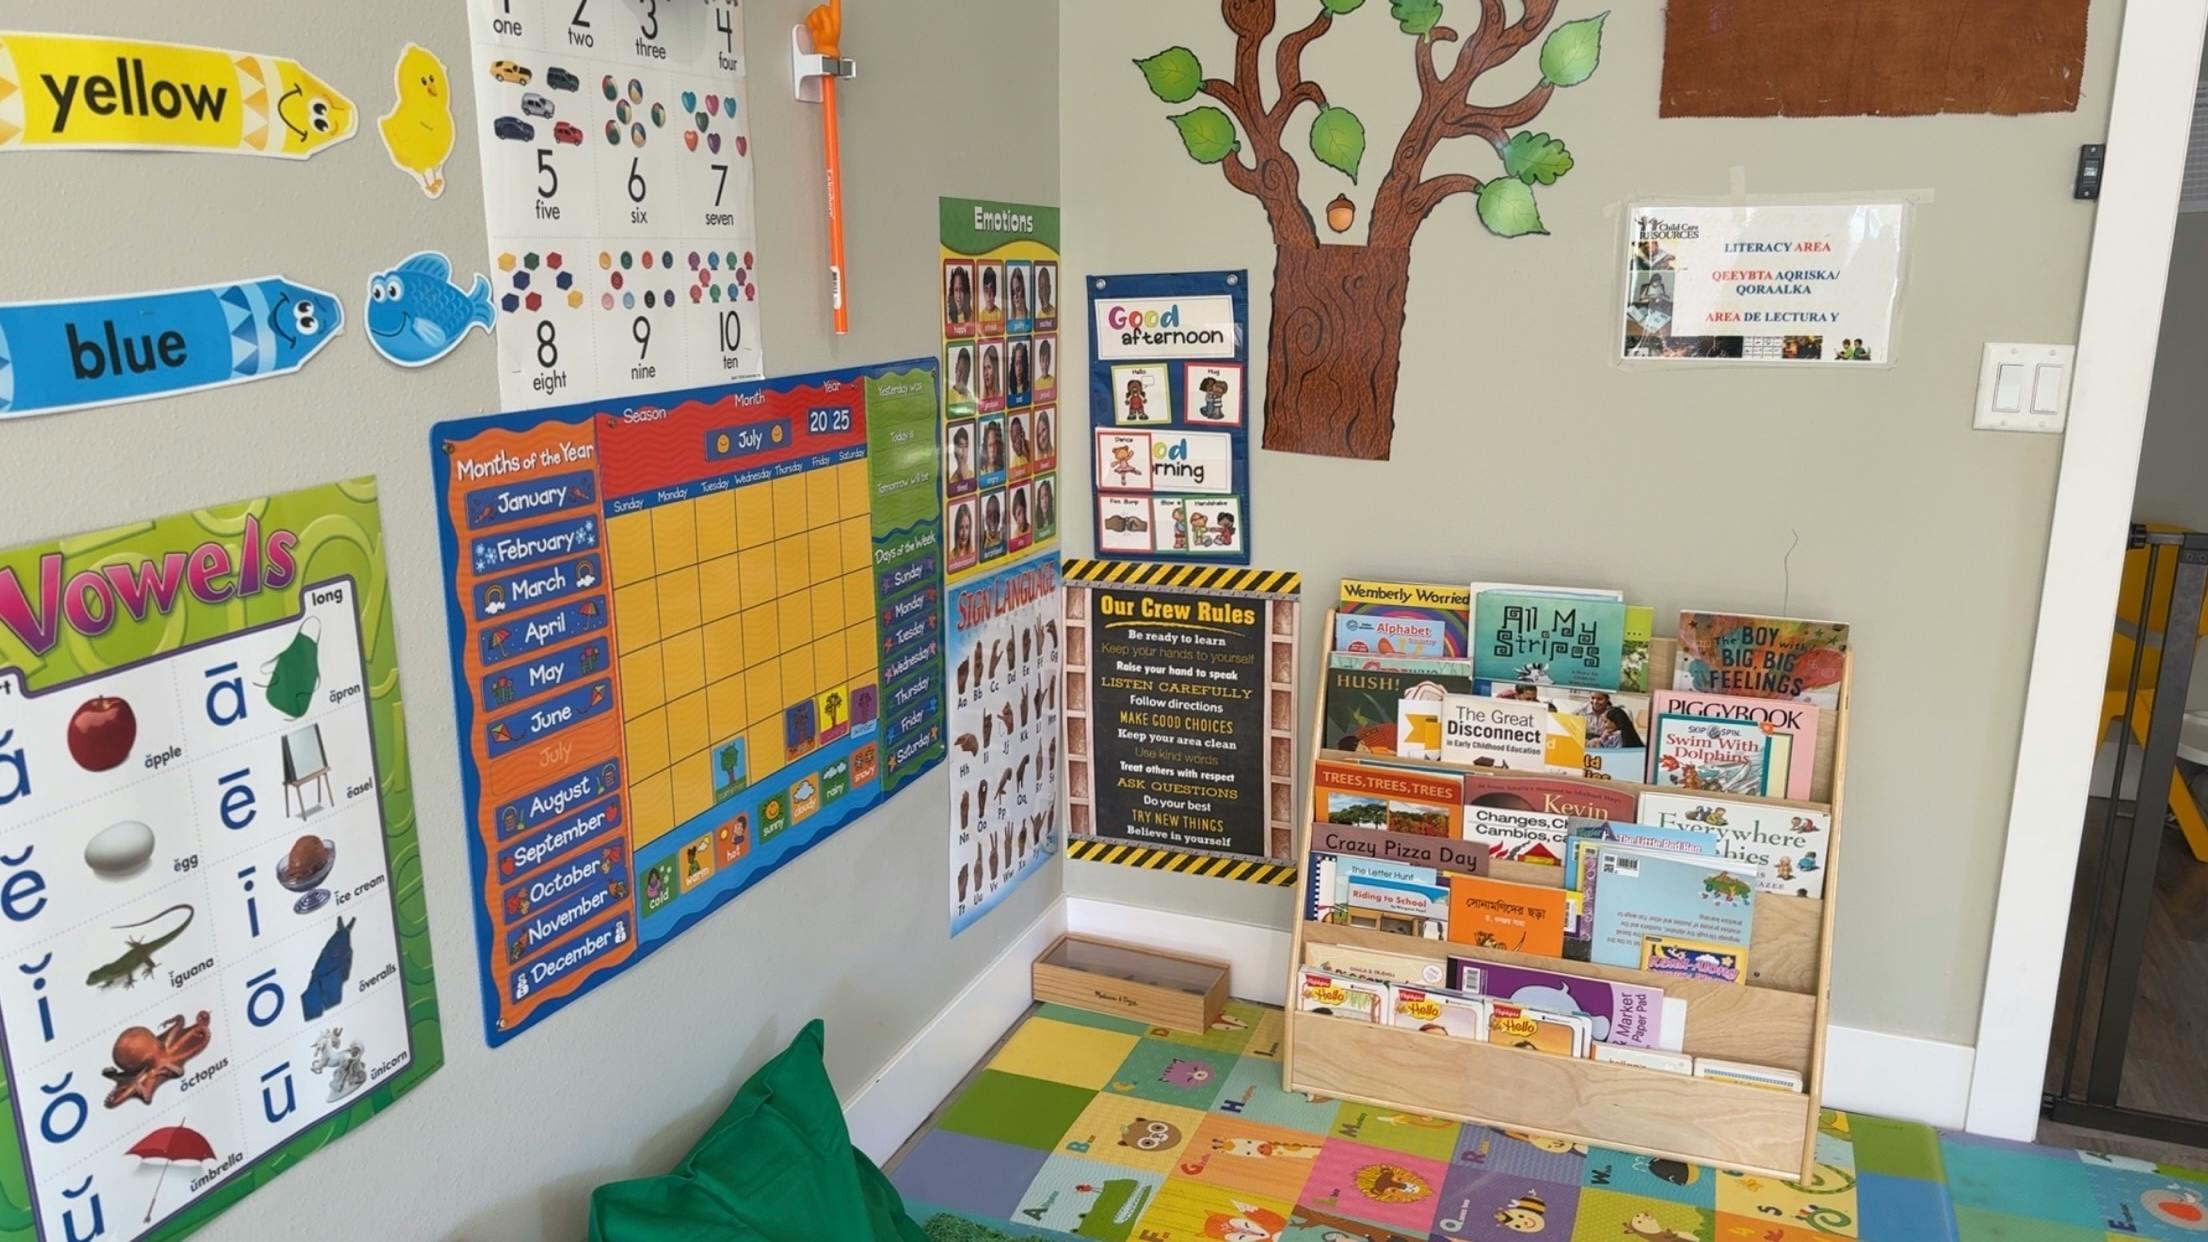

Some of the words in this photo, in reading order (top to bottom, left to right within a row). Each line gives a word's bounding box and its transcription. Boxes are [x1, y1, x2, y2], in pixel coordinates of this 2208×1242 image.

[493, 19, 523, 37] one
[568, 29, 594, 48] two
[716, 8, 733, 53] 4
[635, 38, 666, 60] three
[718, 51, 738, 72] four
[41, 57, 228, 134] yellow
[537, 149, 558, 198] 5
[628, 157, 646, 203] 6
[710, 165, 728, 207] 7
[535, 200, 561, 221] five
[631, 208, 648, 225] six
[705, 212, 734, 227] seven
[974, 206, 1033, 233] Emotions
[1640, 231, 1699, 240] RESOURCES
[1659, 223, 1680, 232] Child
[1681, 223, 1699, 231] Care
[1725, 242, 1792, 253] LITERACY
[1794, 241, 1831, 252] AREA
[1712, 270, 1773, 282] QEEYBTA
[1775, 269, 1840, 282] AQRISKA/
[1736, 284, 1812, 296] QORAALKA
[1108, 304, 1180, 330] Good
[1705, 312, 1742, 323] AREA
[1744, 312, 1762, 322] DE
[1764, 312, 1827, 323] LECTURA
[1829, 312, 1840, 322] Y
[632, 315, 651, 360] 9
[719, 311, 741, 352] 10
[1121, 327, 1224, 346] afternoon
[65, 320, 188, 379] blue
[537, 320, 558, 368] 8
[631, 364, 656, 381] nine
[723, 356, 738, 370] ten
[533, 373, 567, 395] eight
[823, 380, 841, 393] Year
[734, 392, 766, 407] Month
[623, 407, 667, 424] Season
[738, 429, 763, 450] July
[457, 452, 519, 481] Months
[523, 455, 536, 468] of
[540, 450, 560, 466] the
[560, 442, 594, 463] Year
[613, 497, 645, 514] Sunday
[658, 487, 689, 502] Monday
[701, 478, 730, 494] Tuesday
[734, 468, 773, 486] Wednesday
[775, 461, 803, 478] Thursday
[811, 455, 832, 468] Friday
[839, 448, 865, 462] Saturday
[498, 486, 567, 514] January
[497, 532, 575, 563] February
[0, 513, 298, 656] Vowels
[512, 568, 566, 601] March
[1344, 584, 1412, 603] Wemberly
[1416, 588, 1470, 605] Worried
[312, 588, 343, 608] long
[957, 587, 990, 631] SIGN
[994, 562, 1056, 615] LANGUAGE
[1101, 595, 1136, 618] Our
[1141, 598, 1191, 622] Crew
[1198, 602, 1256, 625] Rules
[525, 612, 566, 645] April
[1376, 623, 1431, 636] Alphabet
[1501, 606, 1538, 634] All
[1552, 608, 1597, 645] My
[1742, 626, 1779, 646] BOY
[1128, 629, 1143, 641] Be
[1145, 631, 1178, 645] ready
[1181, 634, 1192, 644] to
[1195, 634, 1226, 646] learn
[1494, 629, 1600, 668] Stripes
[1116, 661, 1142, 673] Raise
[1144, 664, 1166, 676] your
[1169, 665, 1193, 677] hand
[1196, 667, 1207, 678] to
[1209, 669, 1238, 681] speak
[1722, 650, 1758, 670] BIG,
[1763, 652, 1797, 672] BIG
[529, 662, 564, 687] May
[1337, 674, 1400, 691] HUSH!
[1709, 670, 1804, 696] FEELINGS
[1101, 677, 1153, 690] LISTEN
[1159, 682, 1252, 700] CAREFULLY
[1130, 695, 1167, 709] Follow
[1168, 698, 1224, 713] directions
[531, 704, 572, 733] June
[1120, 710, 1149, 726] MAKE
[1152, 714, 1181, 730] GOOD
[1185, 717, 1233, 734] CHOICES
[1456, 705, 1486, 721] The
[1491, 709, 1535, 728] Great
[1118, 729, 1147, 742] Keep
[1149, 733, 1175, 745] your
[1177, 737, 1202, 747] area
[1205, 738, 1237, 750] clean
[1447, 720, 1541, 745] Disconnect
[1666, 733, 1712, 748] Swim
[1719, 737, 1759, 753] With
[539, 743, 573, 768] July
[1454, 739, 1471, 750] Early
[1472, 741, 1505, 753] Childhood
[1506, 744, 1541, 755] Education
[1675, 747, 1750, 764] Dolphins
[1120, 761, 1143, 774] Treat
[1145, 764, 1175, 777] others
[1177, 767, 1199, 779] with
[1201, 770, 1235, 783] respect
[1116, 777, 1146, 790] ASK
[1151, 781, 1239, 799] QUESTIONS
[1322, 771, 1366, 788] TREES,
[1367, 776, 1411, 794] TREES,
[1411, 783, 1453, 799] TREES
[529, 776, 591, 819] August
[1143, 795, 1159, 807] Do
[1159, 798, 1185, 810] your
[1187, 800, 1211, 812] best
[1543, 793, 1609, 820] Kevin
[1131, 809, 1151, 822] TRY
[1155, 812, 1179, 828] NEW
[1183, 816, 1224, 833] THINGS
[1476, 810, 1551, 829] Changes,
[514, 811, 605, 868] September
[1127, 825, 1168, 839] Believe
[1171, 830, 1183, 841] in
[1184, 833, 1231, 848] yourself
[1476, 824, 1550, 842] Cambios,
[1325, 833, 1377, 857] Crazy
[1384, 839, 1431, 860] Pizza
[1439, 847, 1477, 872] Day
[353, 874, 385, 898] cream
[530, 860, 601, 903] October
[1353, 890, 1382, 902] Riding
[1384, 895, 1393, 903] to
[1397, 896, 1427, 908] School
[528, 888, 608, 946] November
[531, 929, 612, 984] December
[1318, 987, 1345, 1001] Hello
[1635, 993, 1647, 1016] Pad
[1411, 1002, 1439, 1016] Hello
[1617, 992, 1633, 1038] Marker
[1506, 1018, 1535, 1033] Hello
[1633, 1018, 1647, 1043] Paper
